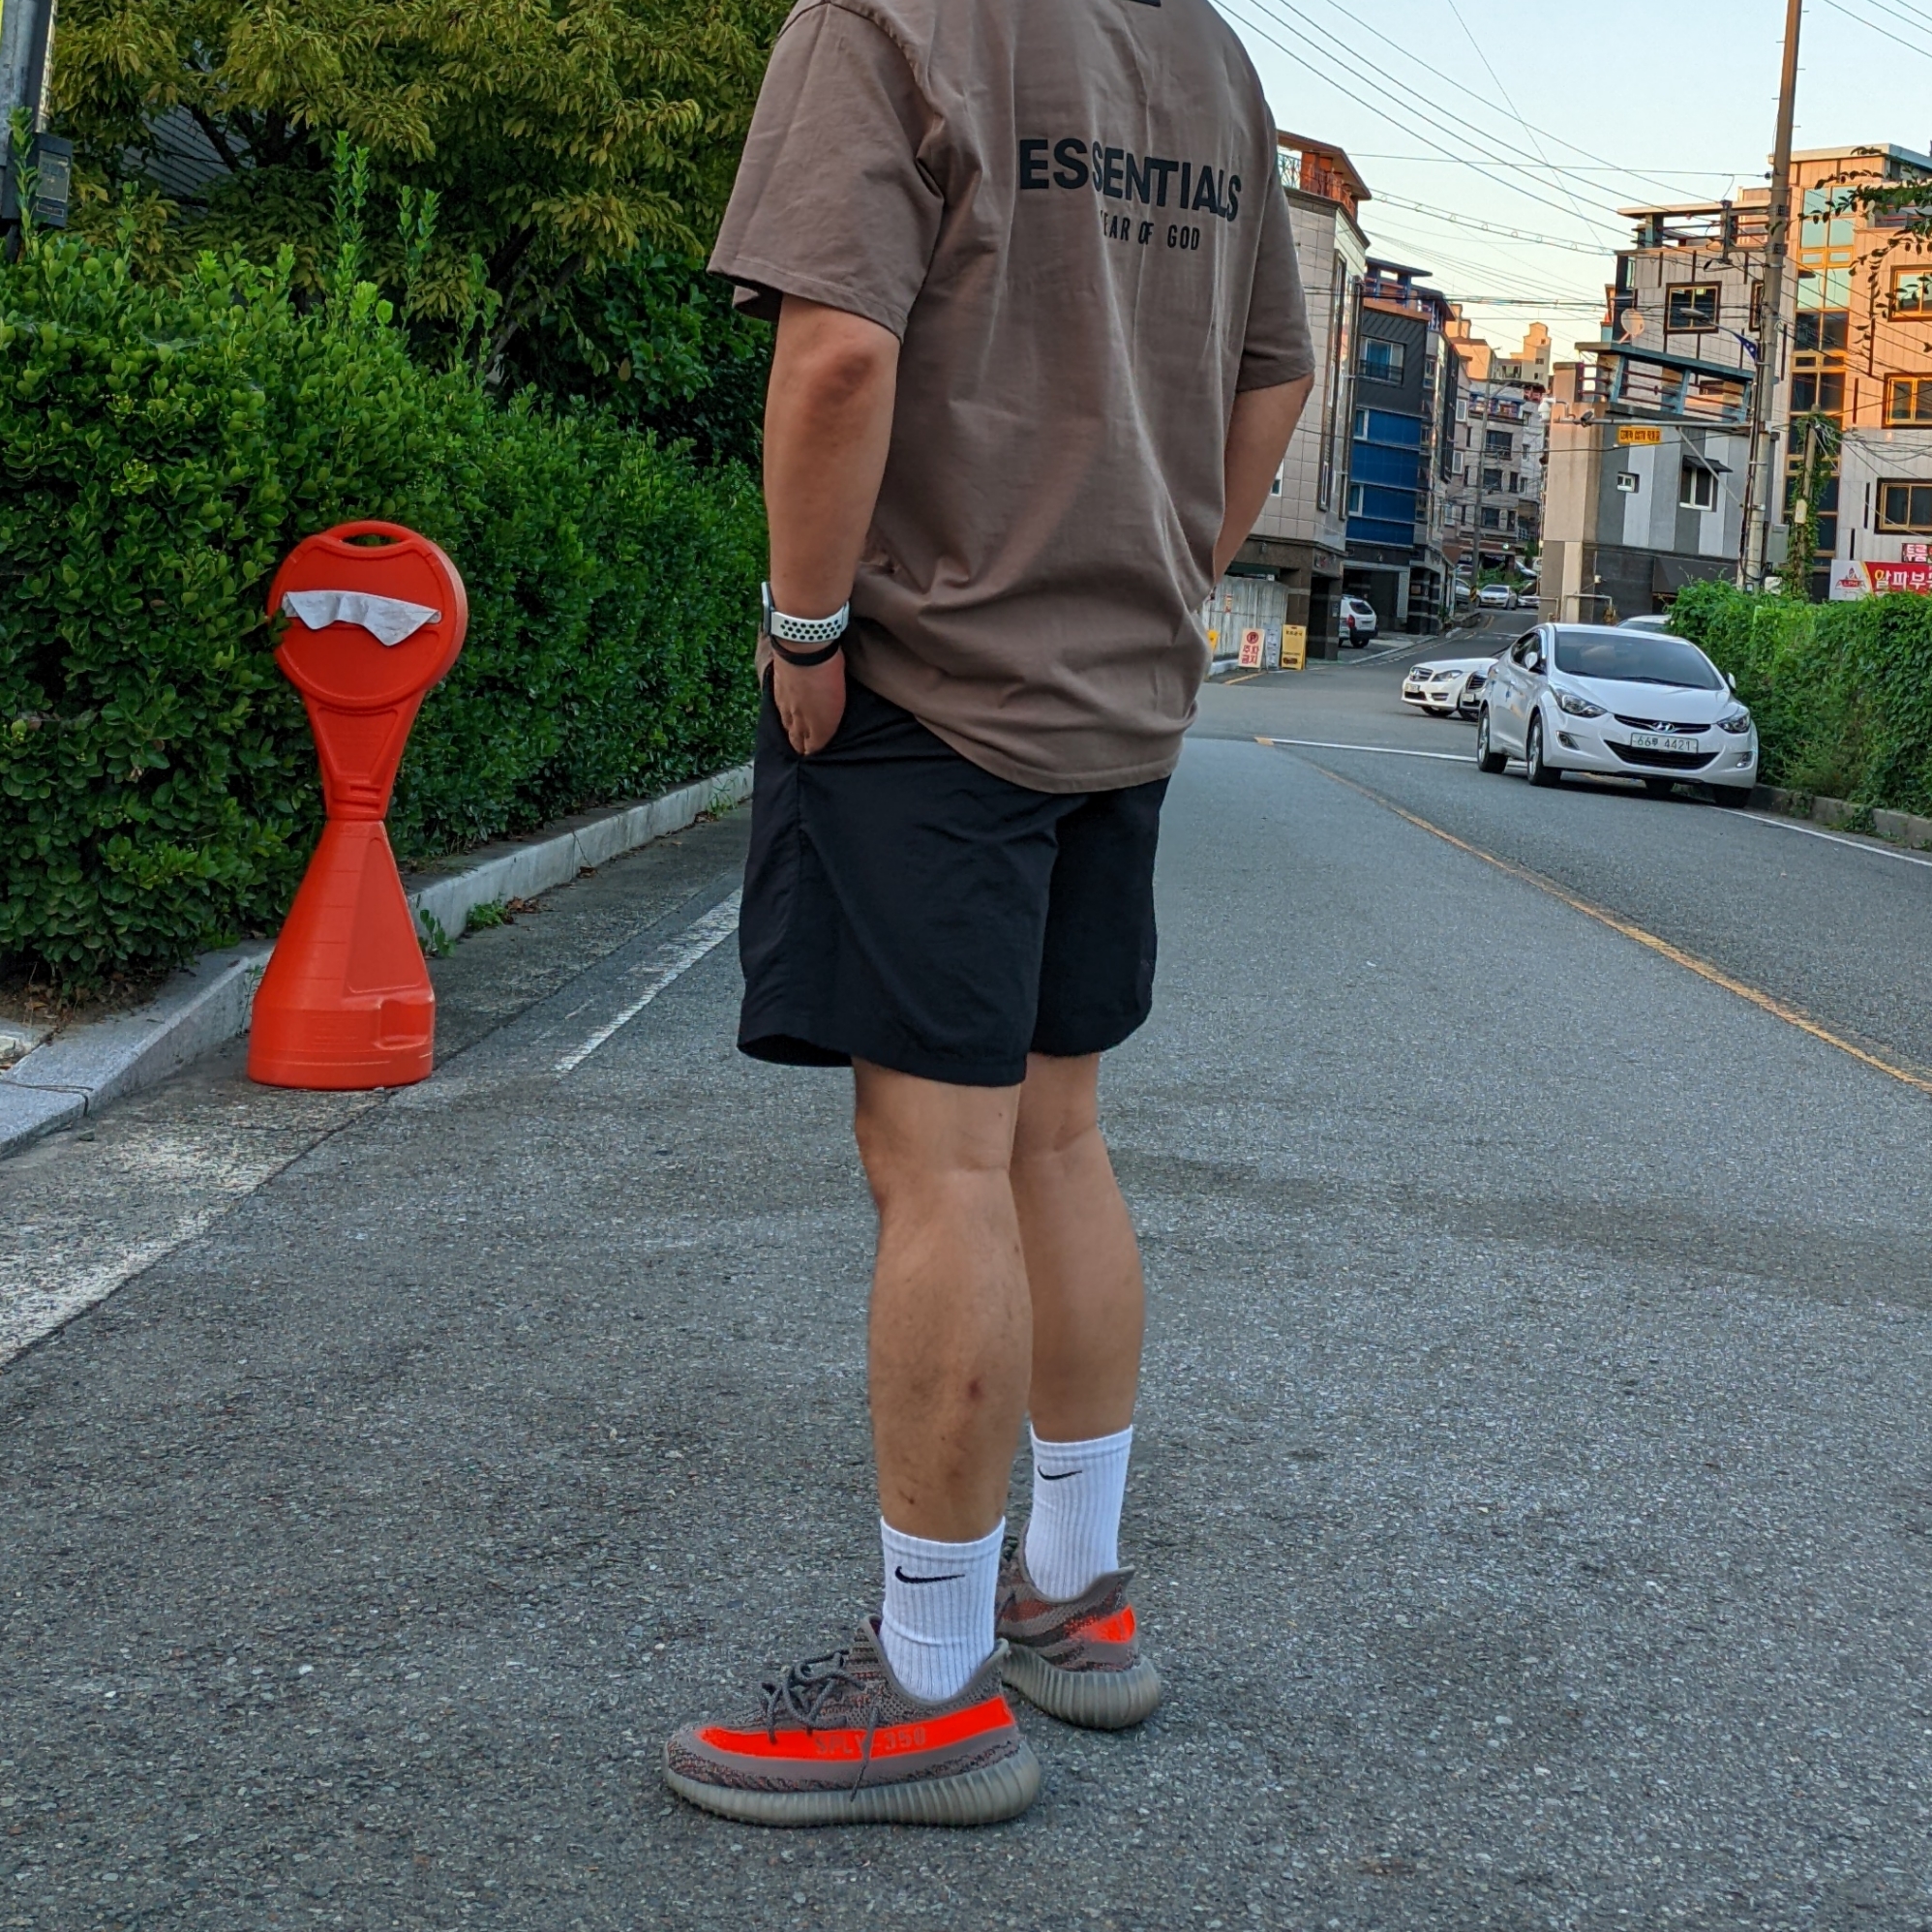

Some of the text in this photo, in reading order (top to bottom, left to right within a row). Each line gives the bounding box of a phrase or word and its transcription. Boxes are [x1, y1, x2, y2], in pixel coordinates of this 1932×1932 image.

[1019, 138, 1241, 222] ESSENTIALS
[1100, 210, 1200, 250] EAR OF GOD
[1664, 739, 1690, 751] 4421
